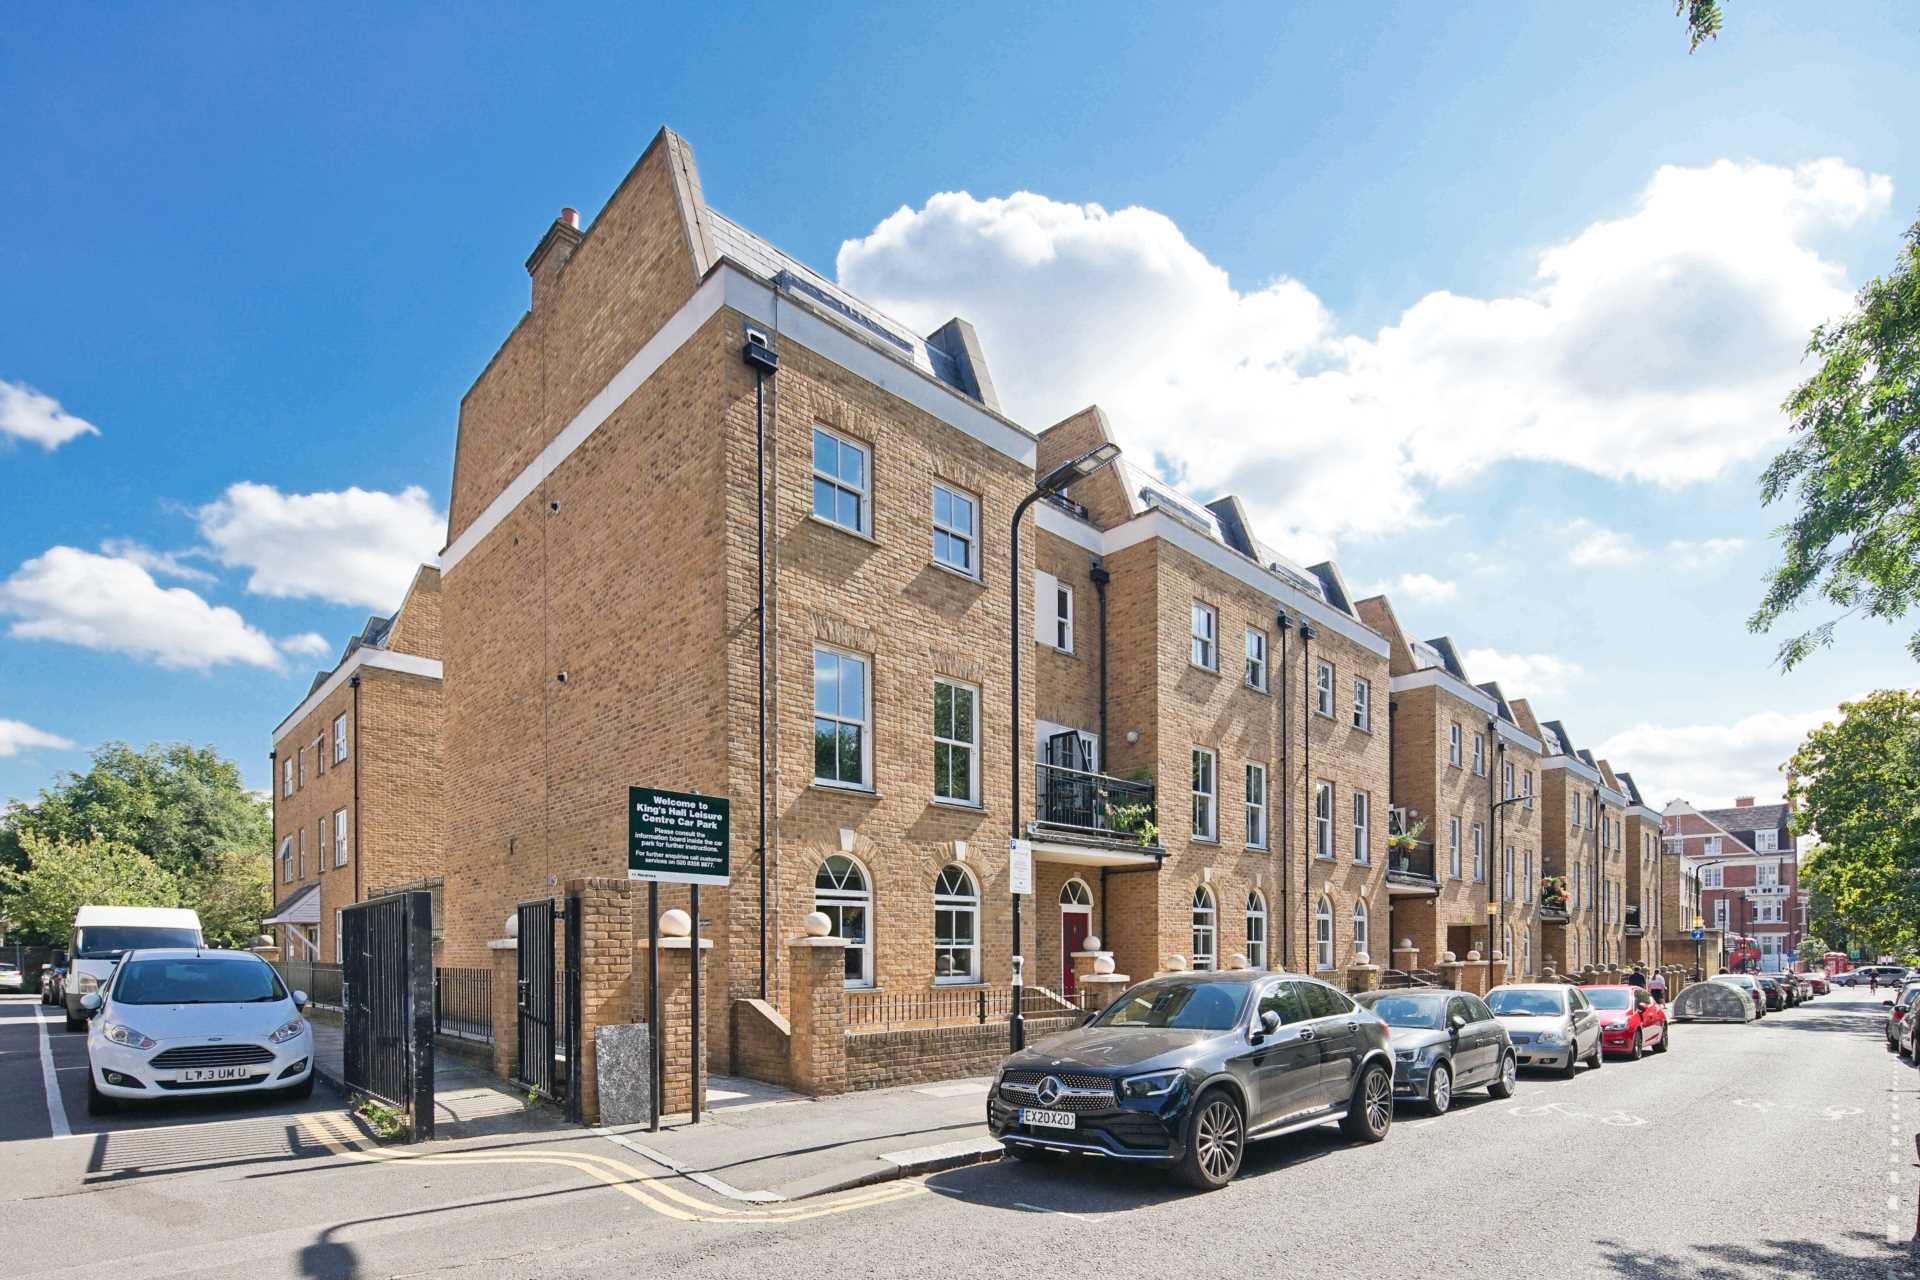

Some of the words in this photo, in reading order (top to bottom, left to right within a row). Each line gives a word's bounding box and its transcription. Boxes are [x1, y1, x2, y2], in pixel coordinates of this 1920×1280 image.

[653, 796, 696, 809] Welcome
[699, 802, 708, 810] to
[636, 803, 667, 815] King's
[669, 807, 687, 817] Hall
[689, 810, 723, 821] Leisure
[642, 813, 675, 825] Centre
[678, 817, 694, 827] Car
[697, 820, 718, 830] Park
[635, 832, 668, 841] information
[669, 835, 686, 843] board
[654, 827, 674, 835] Please
[675, 829, 696, 837] consult
[696, 830, 706, 838] the
[641, 840, 655, 848] park
[656, 840, 664, 848] for
[665, 842, 685, 850] further
[685, 844, 719, 852] instructions.
[646, 850, 664, 858] further
[645, 857, 667, 865] services
